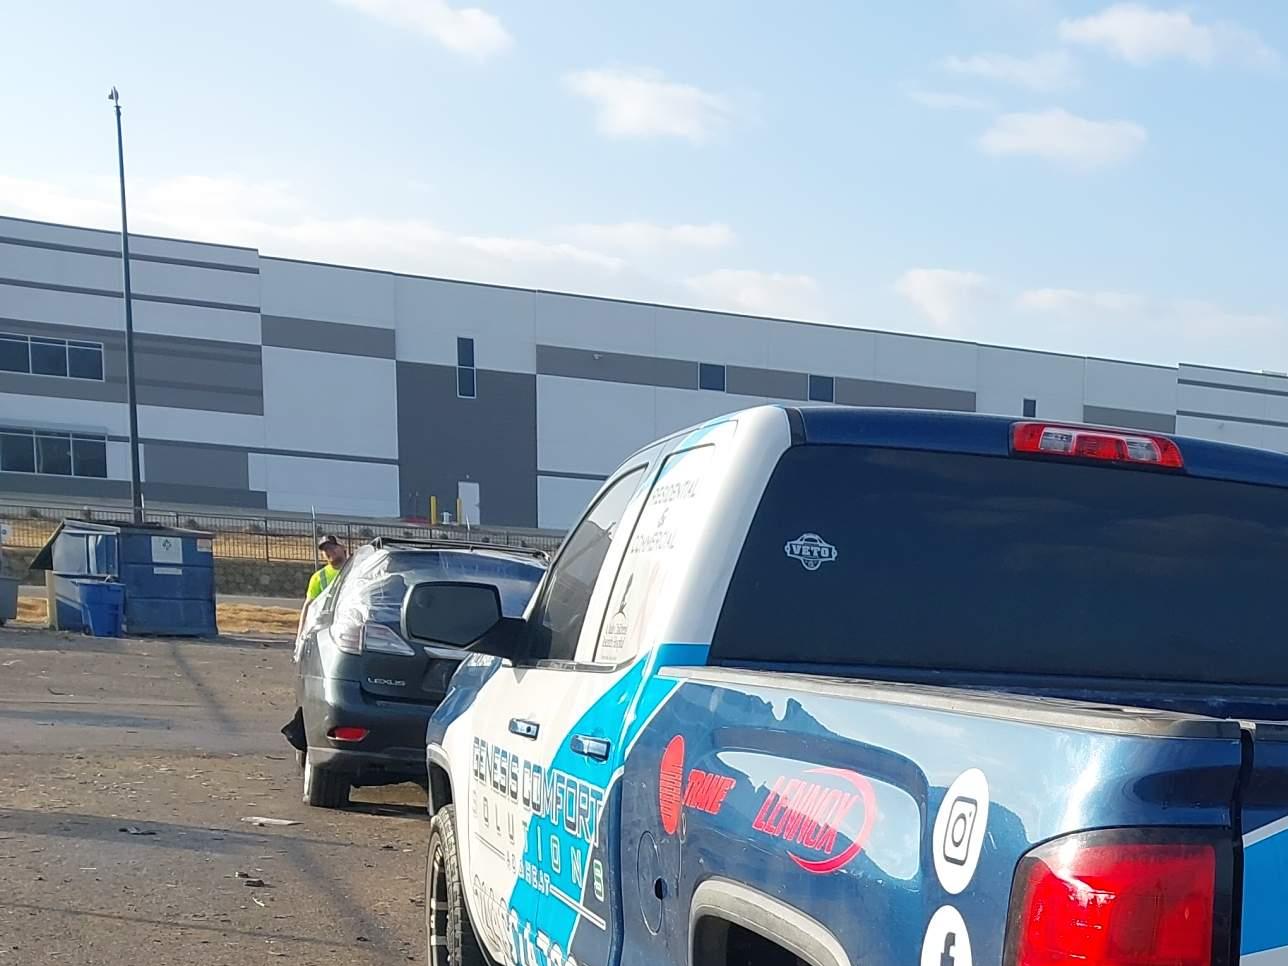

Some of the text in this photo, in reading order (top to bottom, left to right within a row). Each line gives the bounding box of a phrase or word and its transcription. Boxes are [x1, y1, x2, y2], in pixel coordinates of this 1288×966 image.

[791, 544, 830, 558] VETO
[367, 677, 406, 686] LEXUS
[472, 736, 605, 849] GENESIS COMFORT
[682, 768, 736, 815] TRANE
[751, 775, 860, 855] LENNOX
